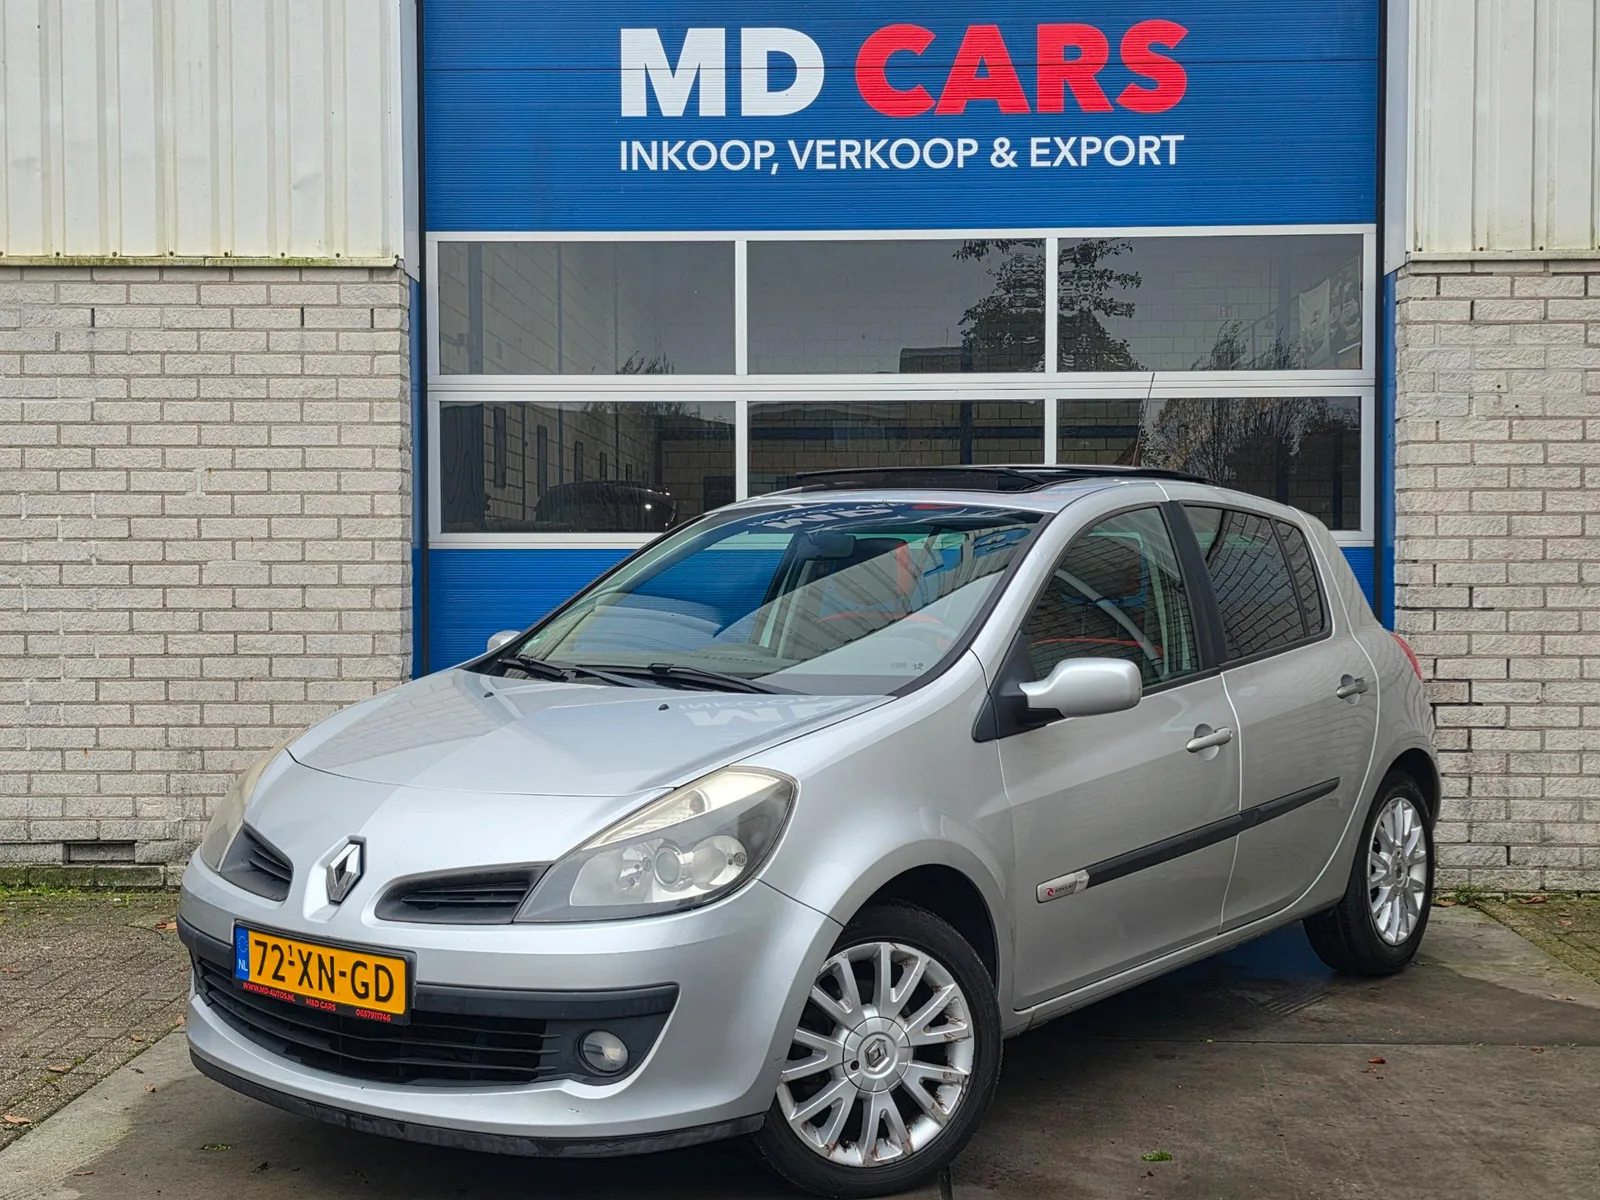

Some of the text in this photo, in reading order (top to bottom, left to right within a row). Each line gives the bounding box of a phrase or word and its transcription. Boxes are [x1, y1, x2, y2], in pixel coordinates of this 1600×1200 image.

[620, 19, 1189, 117] MD CARS
[620, 134, 1185, 175] INKOOP, VERKOOP & EXPORT
[238, 958, 248, 972] NL
[242, 982, 296, 1003] WWW.MD-AUTOS.NL
[305, 998, 337, 1012] M&D CARS
